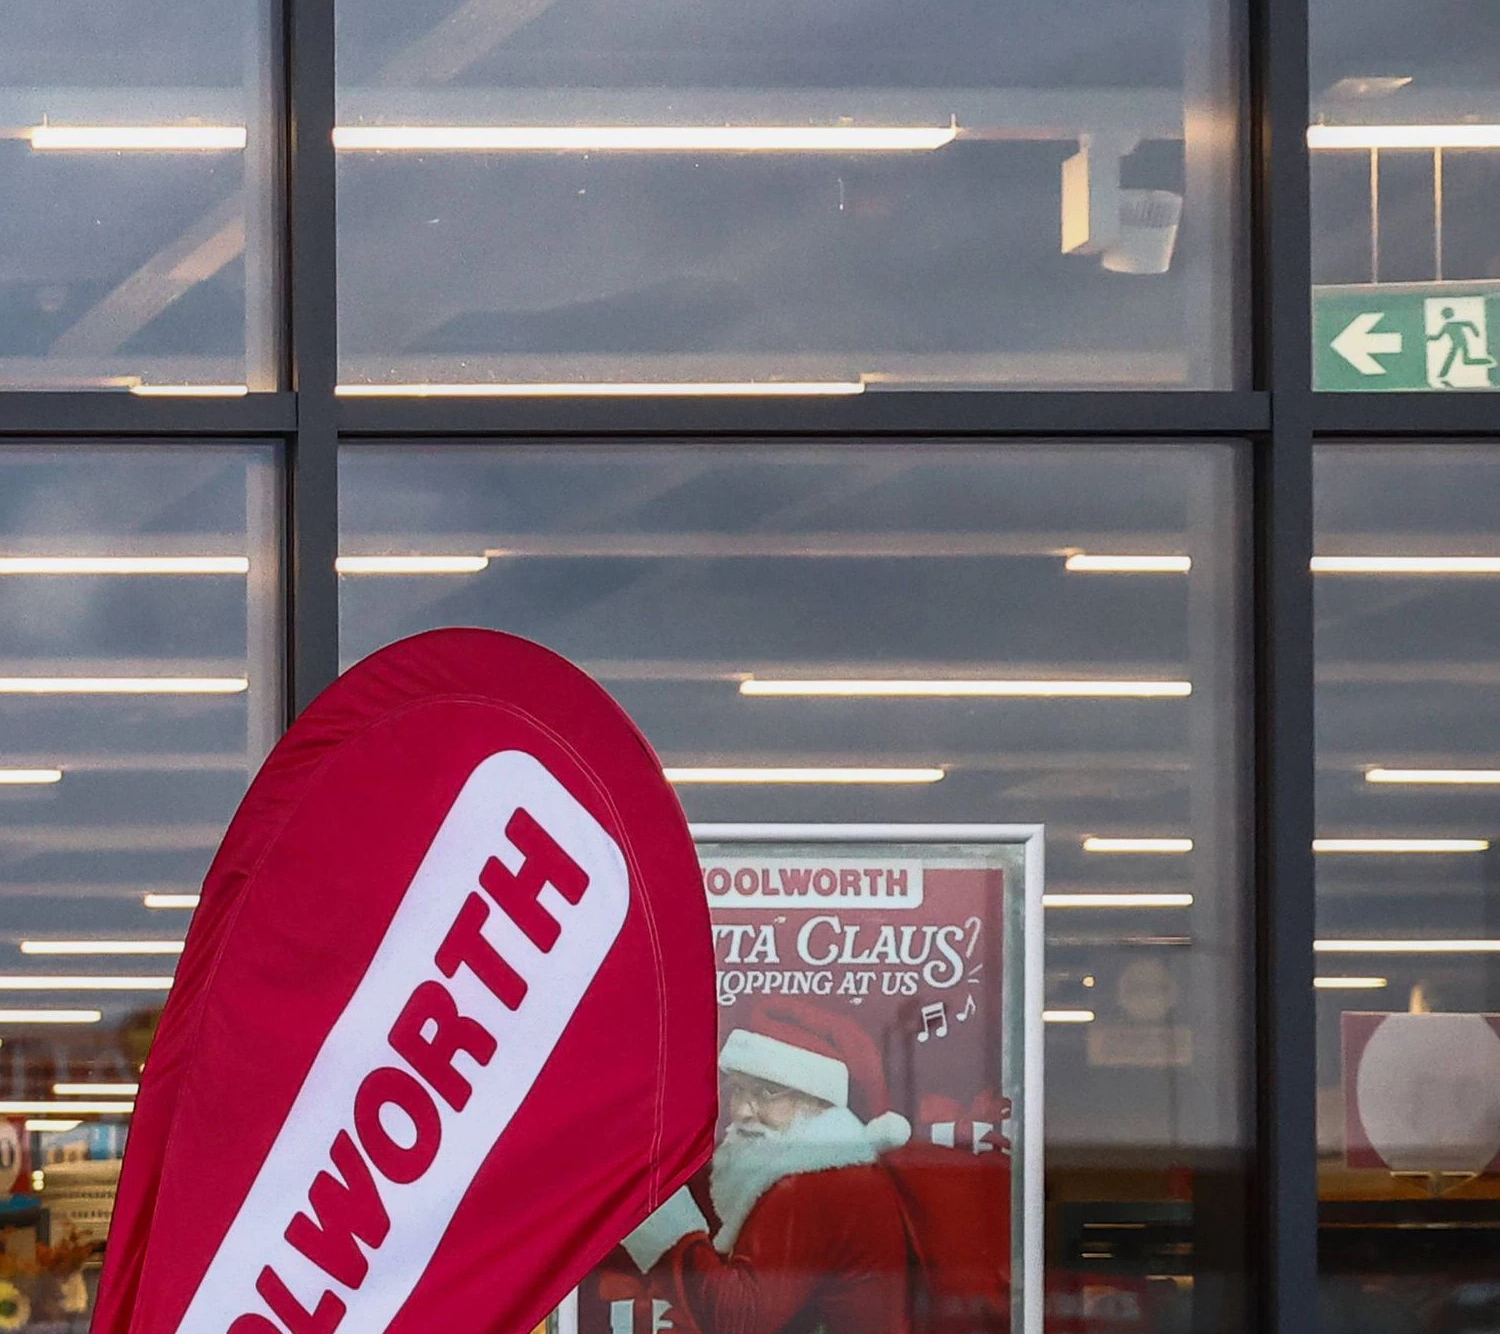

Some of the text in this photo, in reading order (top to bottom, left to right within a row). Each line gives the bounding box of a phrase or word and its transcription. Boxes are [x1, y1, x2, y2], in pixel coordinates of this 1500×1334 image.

[703, 868, 908, 896] OOLWORTH
[711, 923, 780, 964] TA
[837, 971, 877, 995] AT
[882, 971, 919, 995] US
